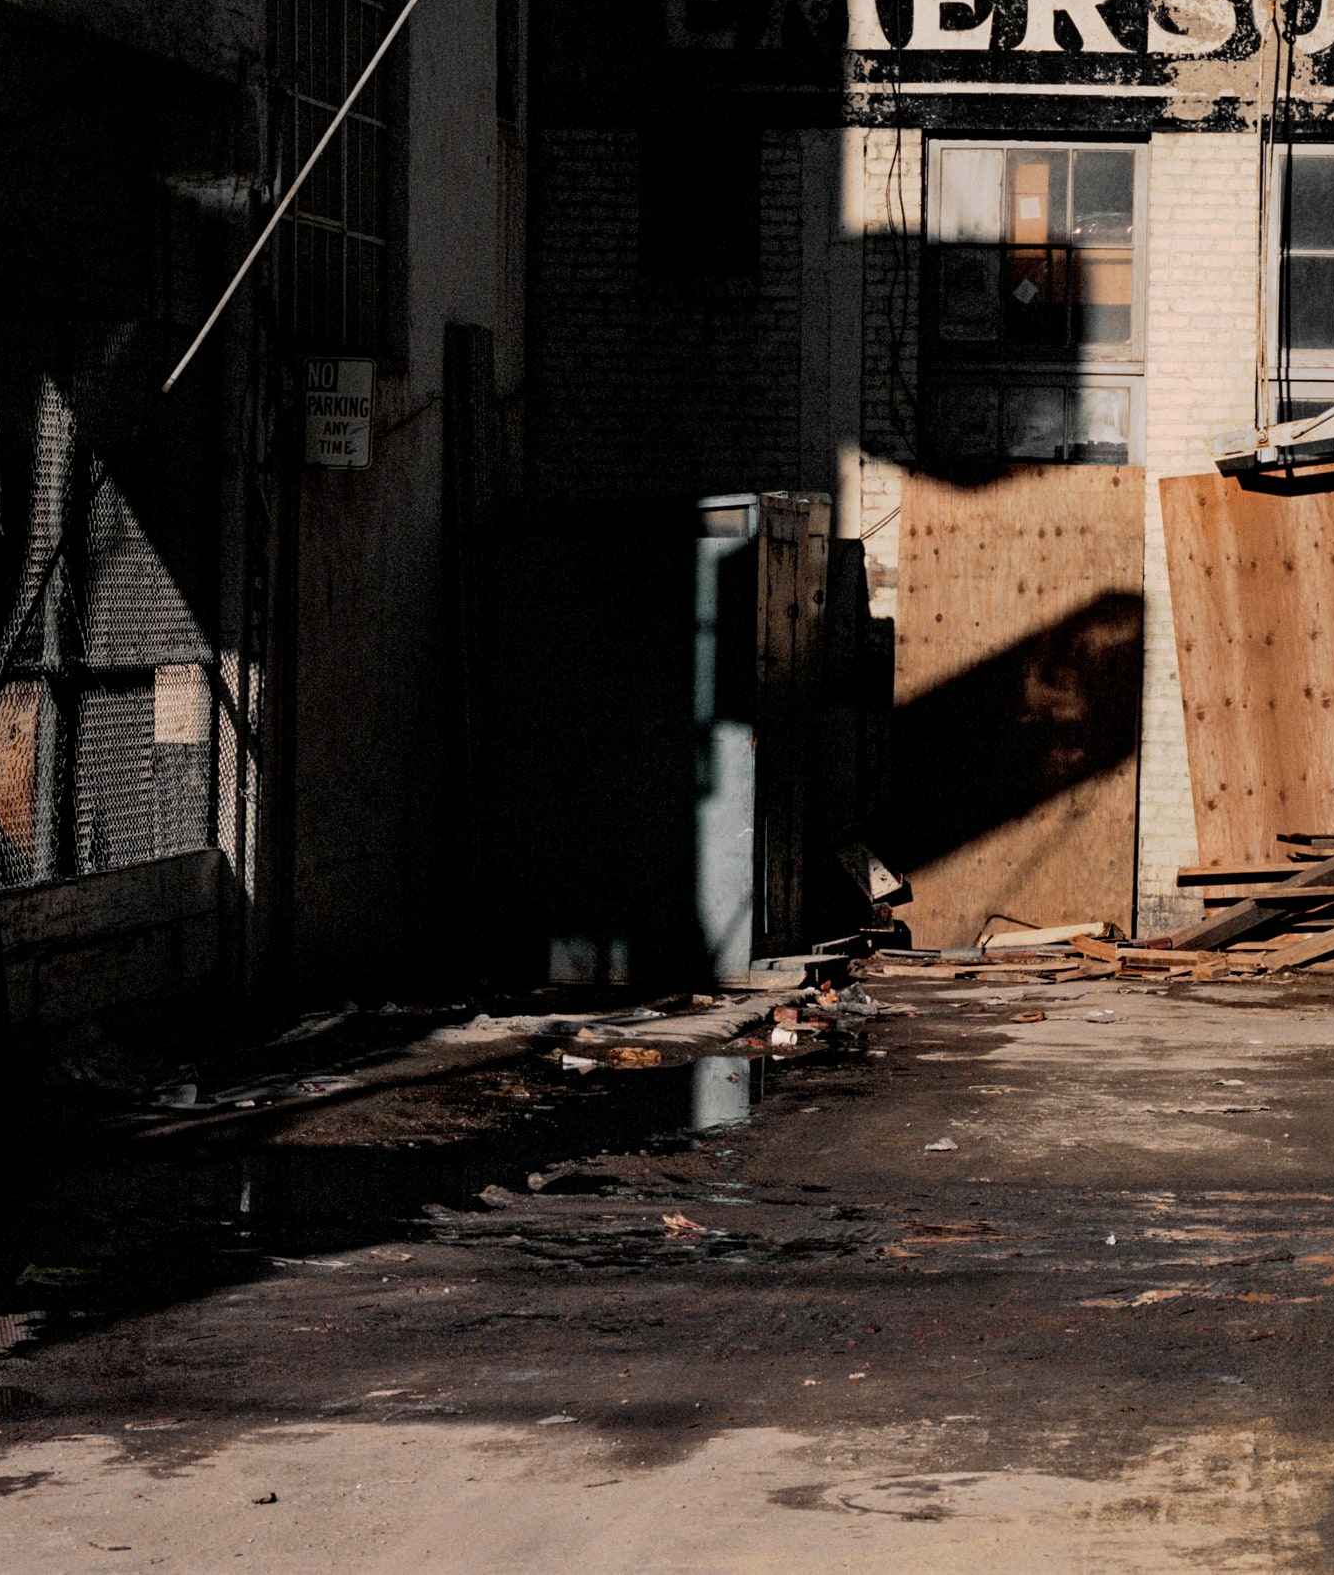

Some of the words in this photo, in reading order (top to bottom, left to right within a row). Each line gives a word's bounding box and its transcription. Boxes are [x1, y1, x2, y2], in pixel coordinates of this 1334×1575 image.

[307, 361, 336, 389] NO
[306, 395, 370, 418] PARKING
[323, 421, 350, 435] ANY
[319, 439, 352, 454] TIME
